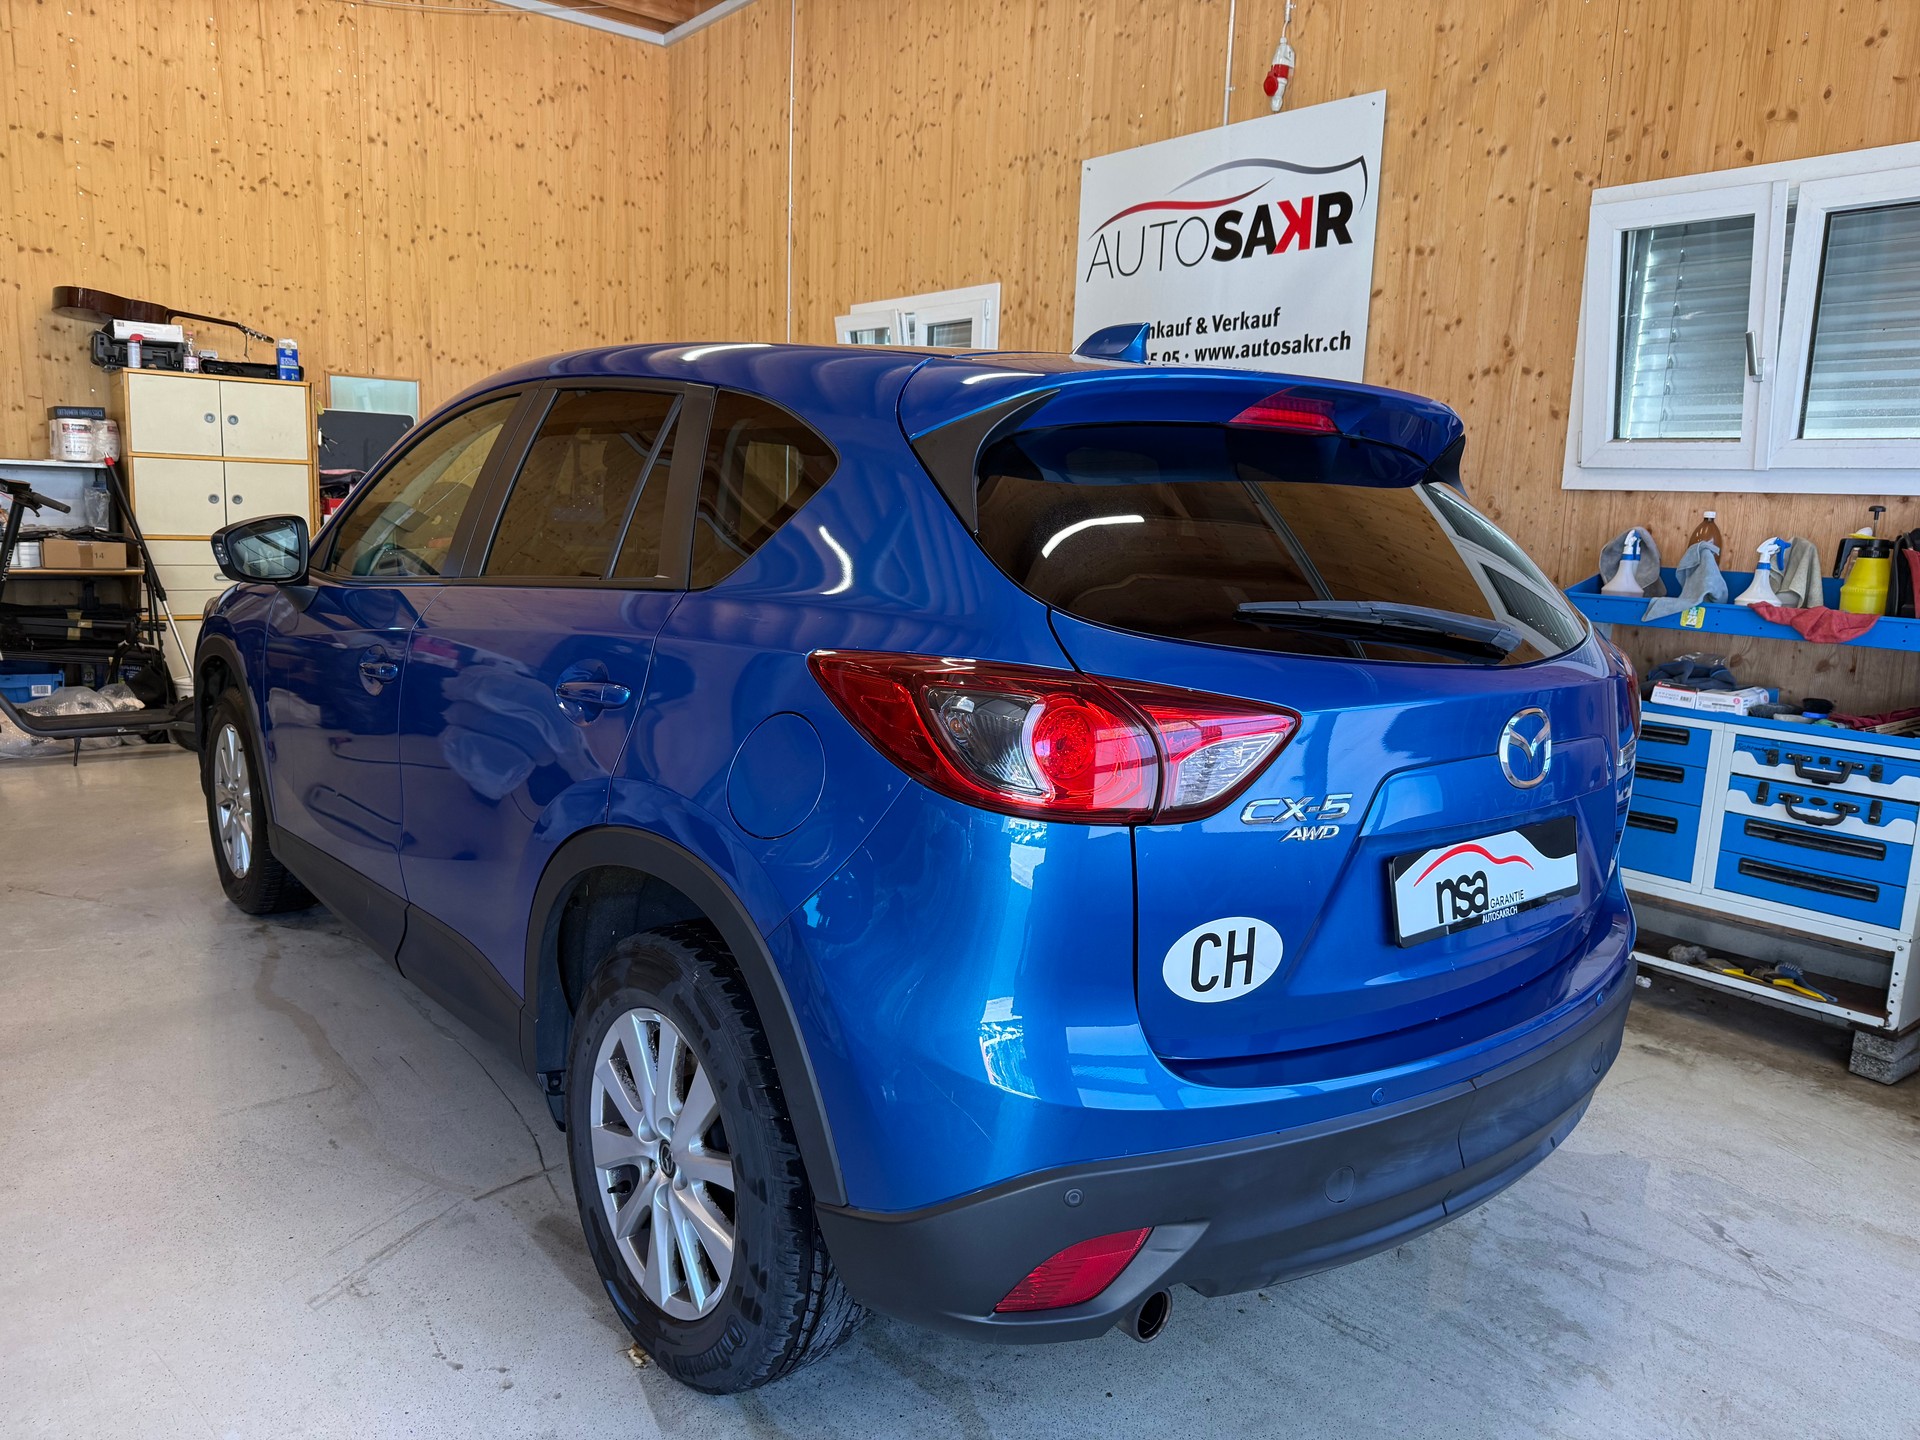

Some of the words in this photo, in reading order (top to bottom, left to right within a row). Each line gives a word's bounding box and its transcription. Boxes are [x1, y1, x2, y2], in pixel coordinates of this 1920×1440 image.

[1147, 316, 1193, 340] nkauf
[1196, 316, 1209, 335] &
[1212, 307, 1282, 333] Verkauf
[1194, 330, 1352, 363] www.autosakr.ch
[94, 552, 105, 560] 14
[1240, 793, 1353, 825] CX-5
[1279, 824, 1340, 843] AWD
[1436, 870, 1489, 925] nsa
[1490, 889, 1525, 909] GARANTIE
[1482, 905, 1518, 924] AUTOSAKR.CH
[1190, 926, 1256, 993] CH
